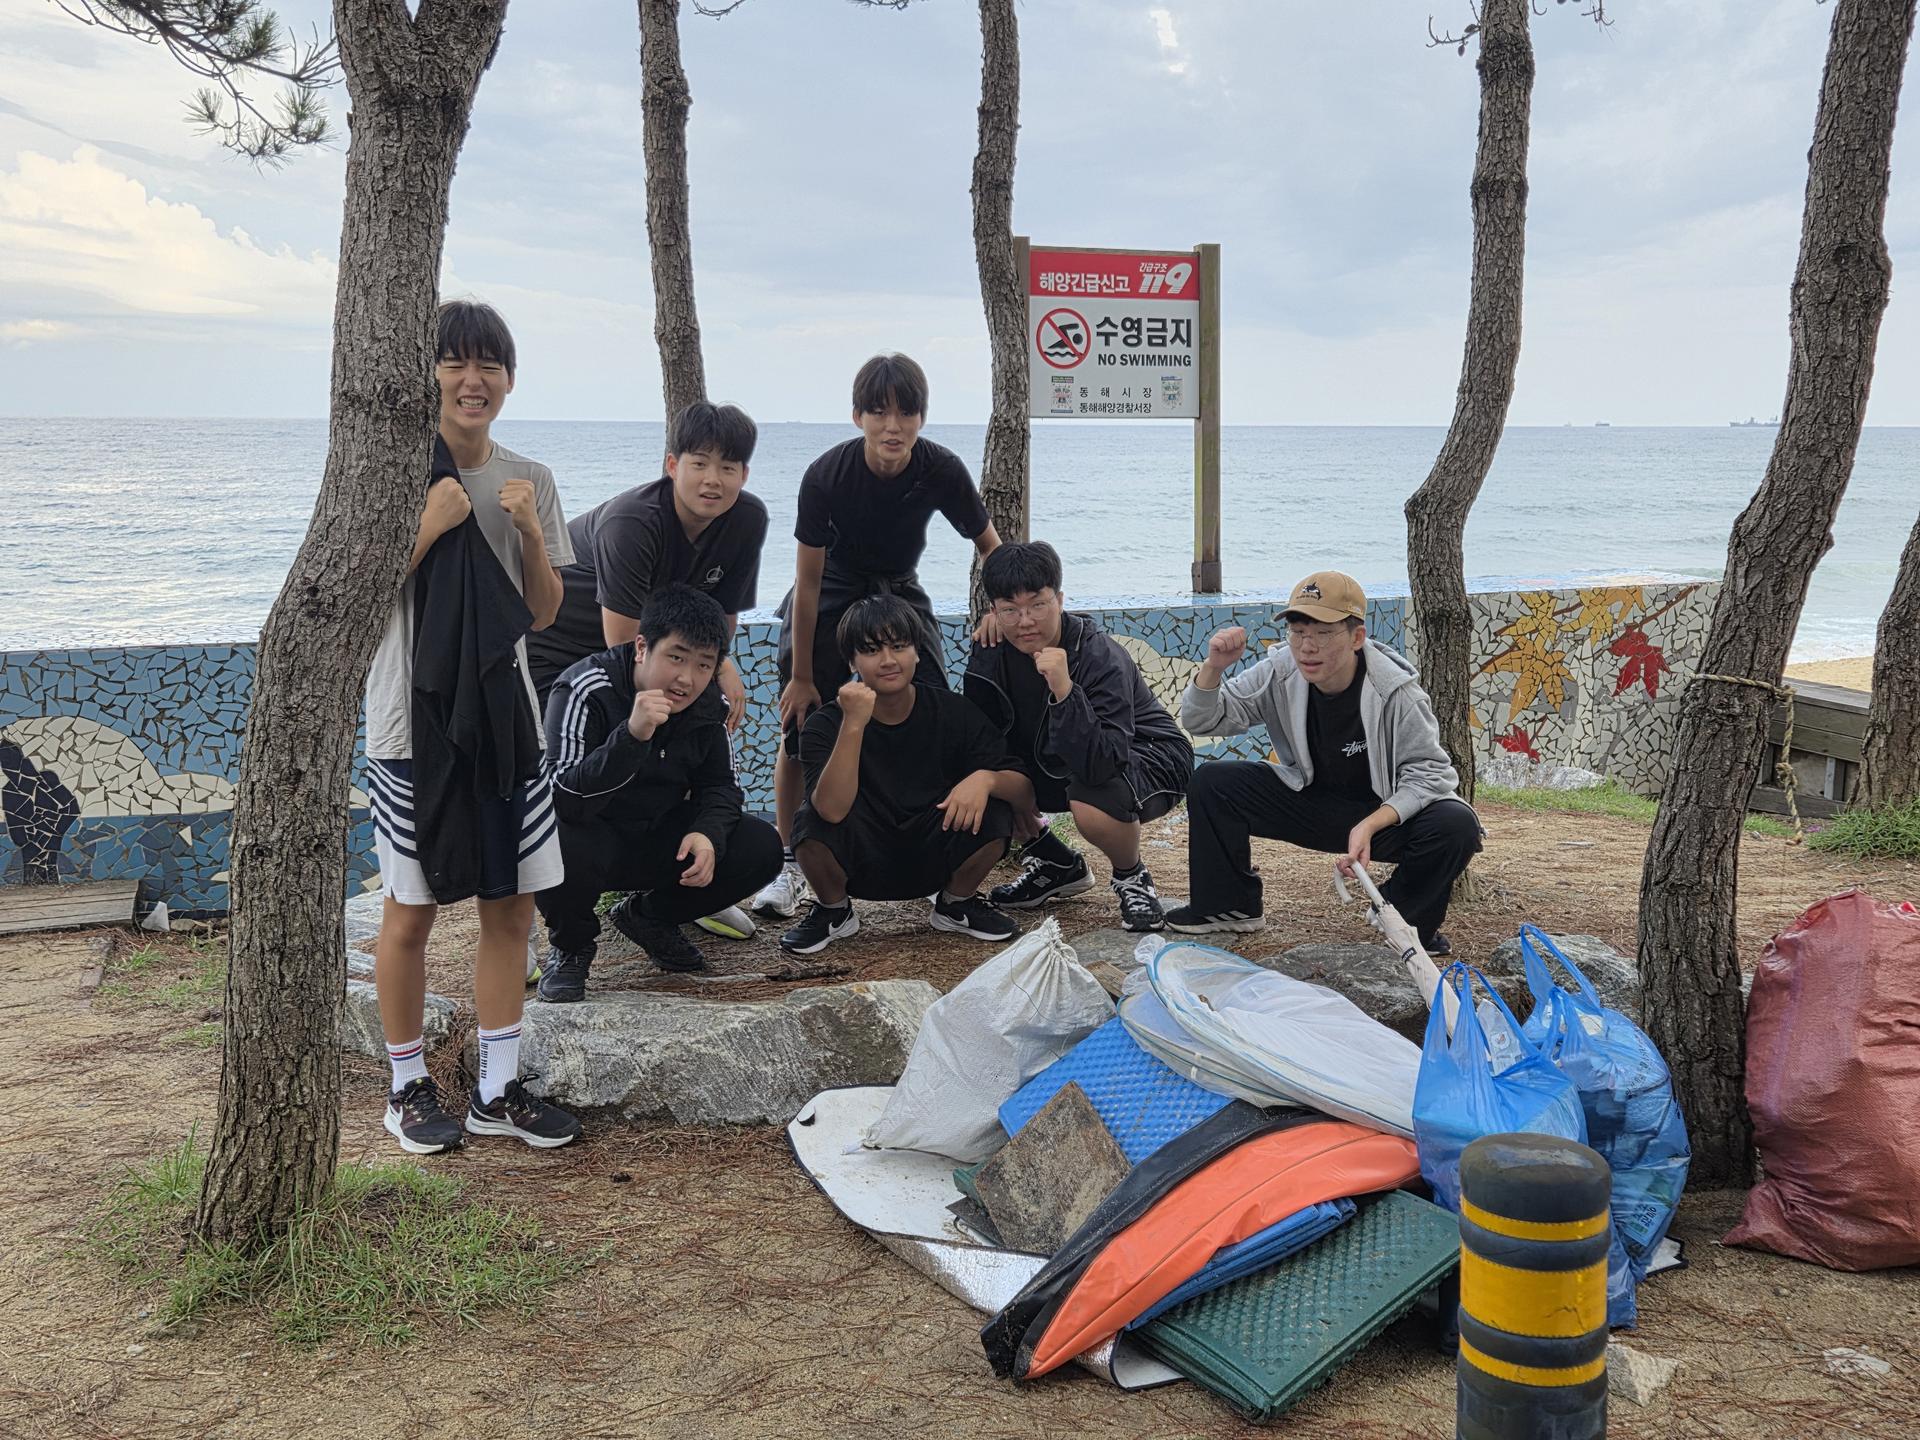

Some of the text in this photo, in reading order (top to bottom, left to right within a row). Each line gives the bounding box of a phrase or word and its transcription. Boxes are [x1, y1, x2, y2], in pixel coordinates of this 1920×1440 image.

[1139, 262, 1168, 273] 긴급구조
[1039, 262, 1193, 294] 해양긴급신고 119
[1096, 316, 1192, 348] 수영금지
[1097, 353, 1192, 367] NO SWIMMING
[1079, 402, 1152, 414] 동해해양경찰서장
